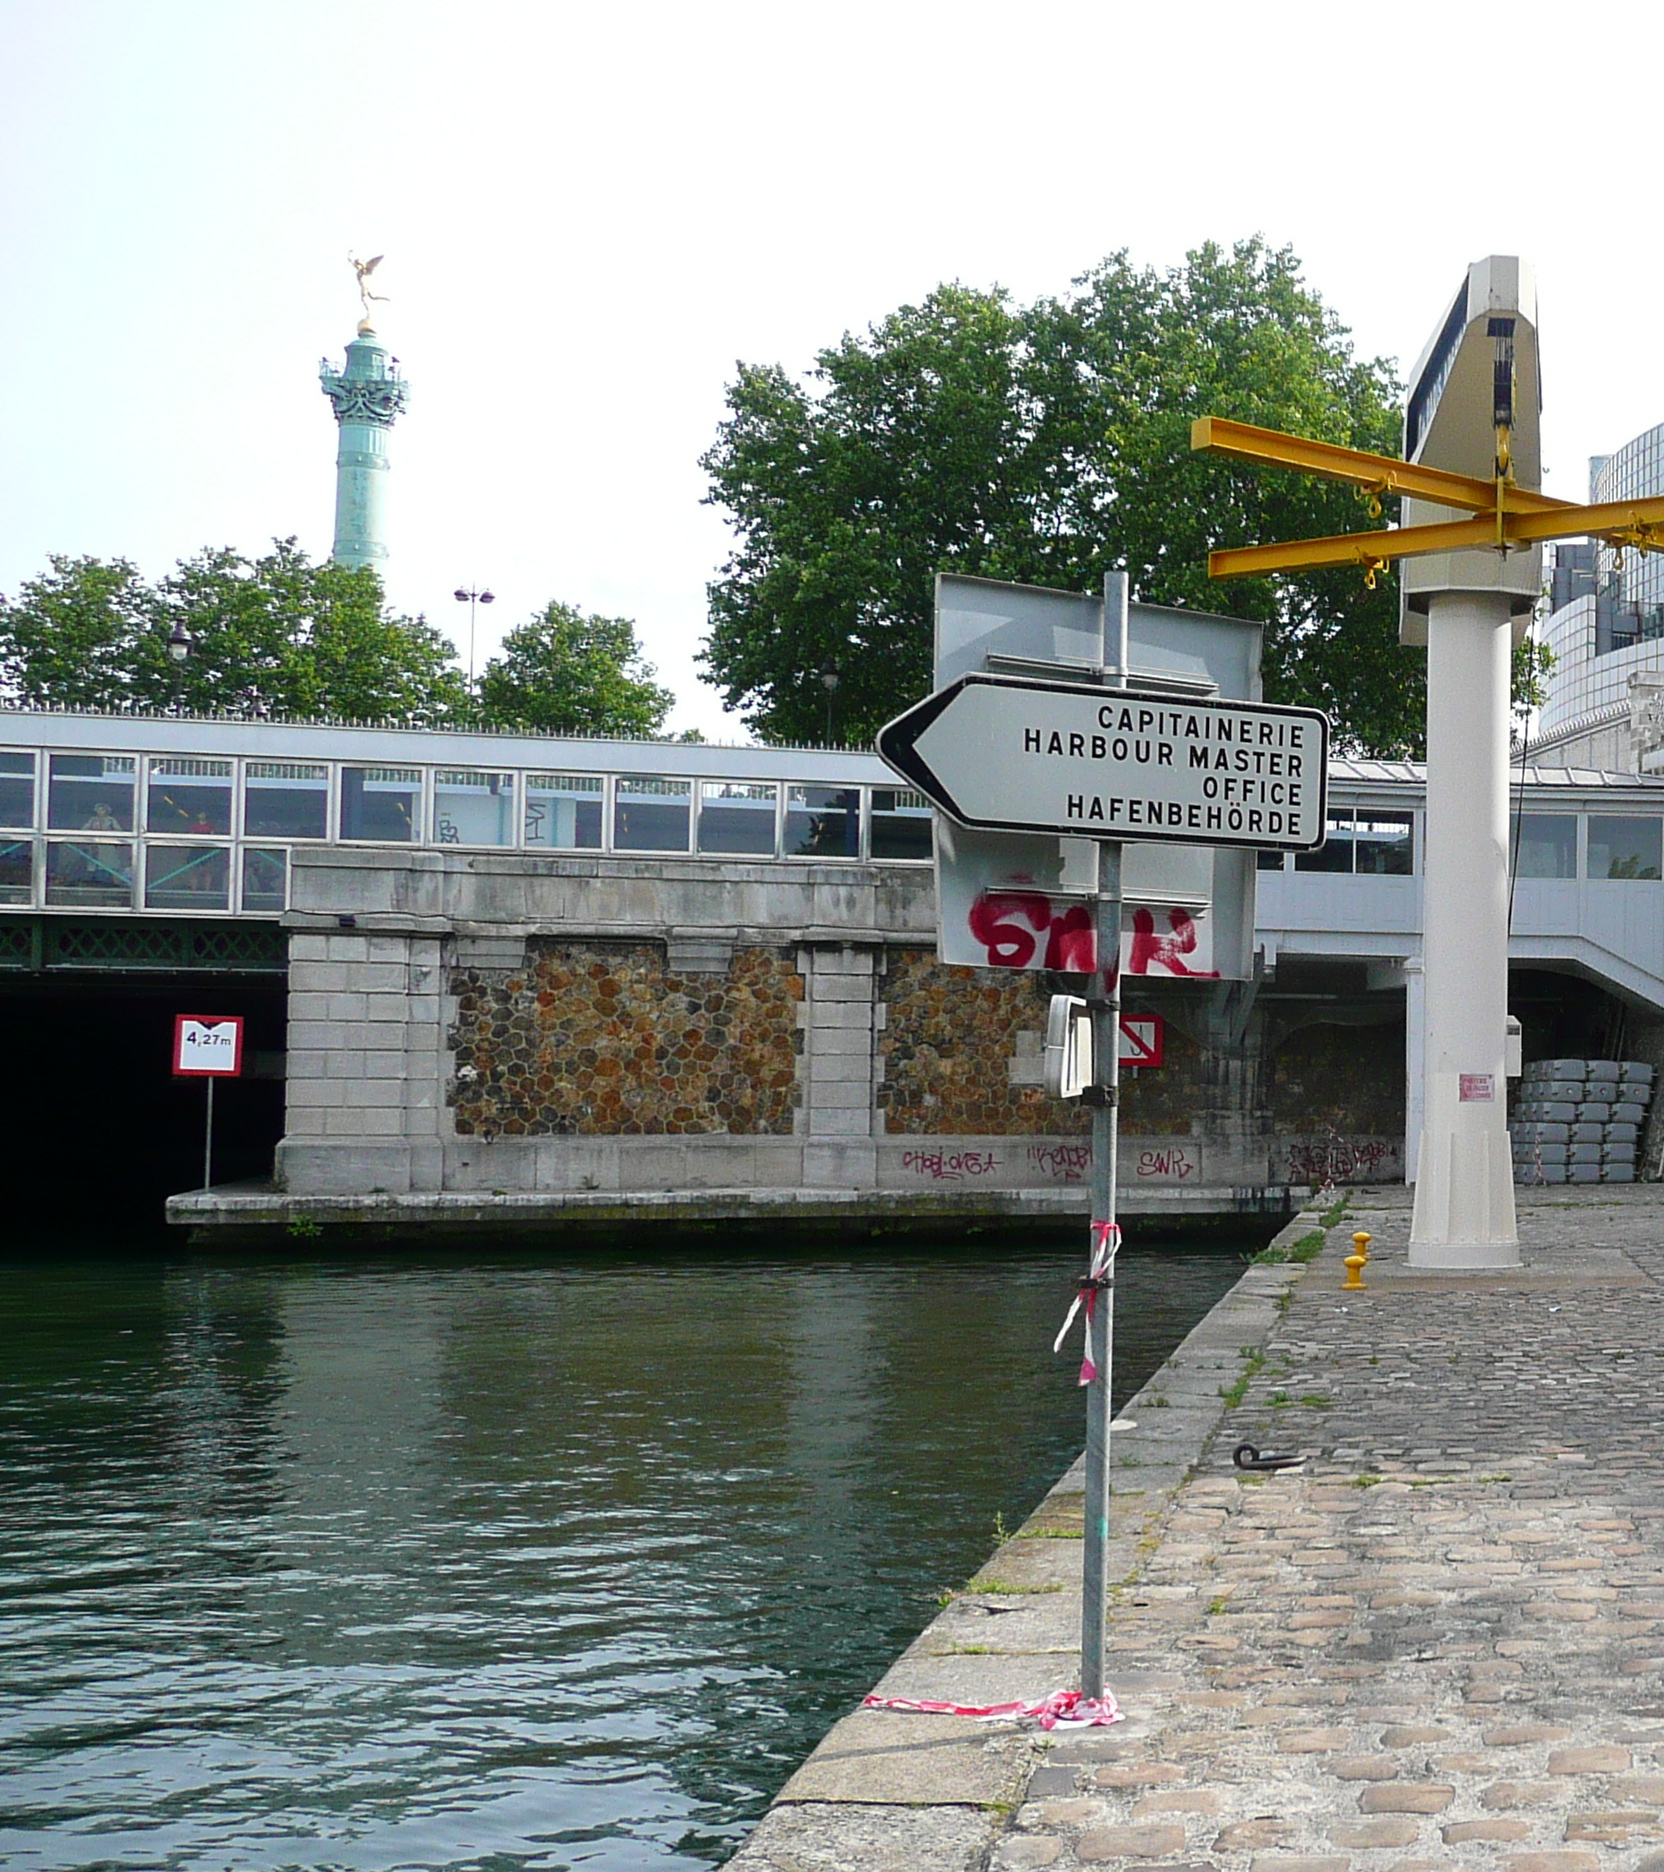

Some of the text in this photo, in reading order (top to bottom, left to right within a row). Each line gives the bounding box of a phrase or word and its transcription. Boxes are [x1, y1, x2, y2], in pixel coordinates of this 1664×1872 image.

[1098, 705, 1304, 749] CAPITAINERIE
[1024, 727, 1302, 778] HARBOUR MASTER
[1203, 776, 1302, 806] OFFICE
[1066, 794, 1301, 836] HAFENBEHÖRDE
